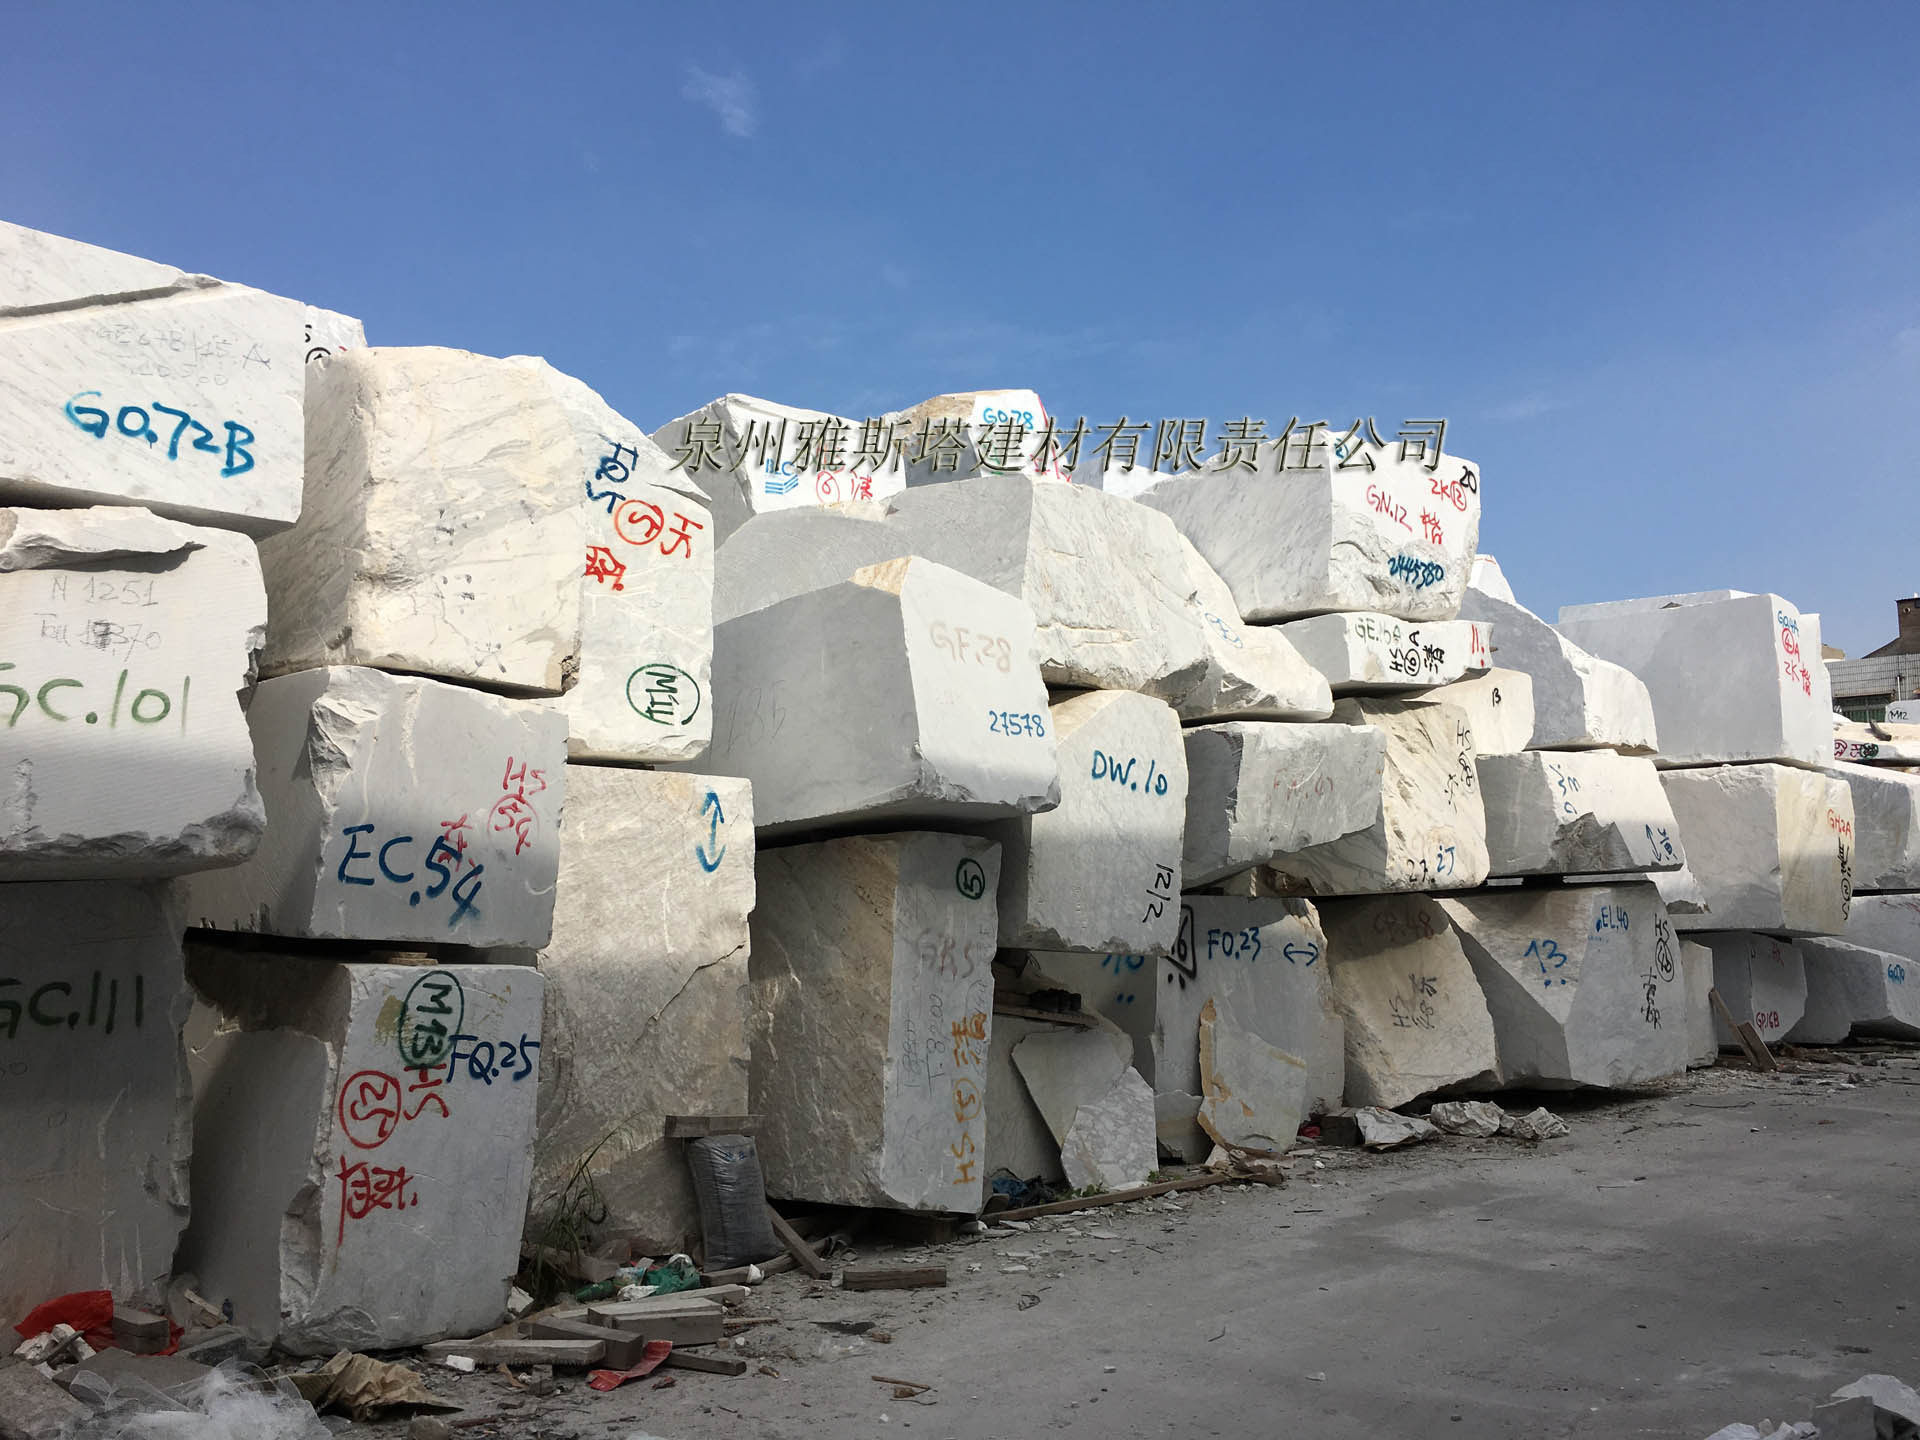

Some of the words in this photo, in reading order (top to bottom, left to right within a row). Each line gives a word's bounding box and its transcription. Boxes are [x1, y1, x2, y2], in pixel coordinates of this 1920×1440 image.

[1091, 749, 1169, 797] DW.10
[337, 823, 484, 927] EC.54
[446, 1033, 541, 1086] FQ.25
